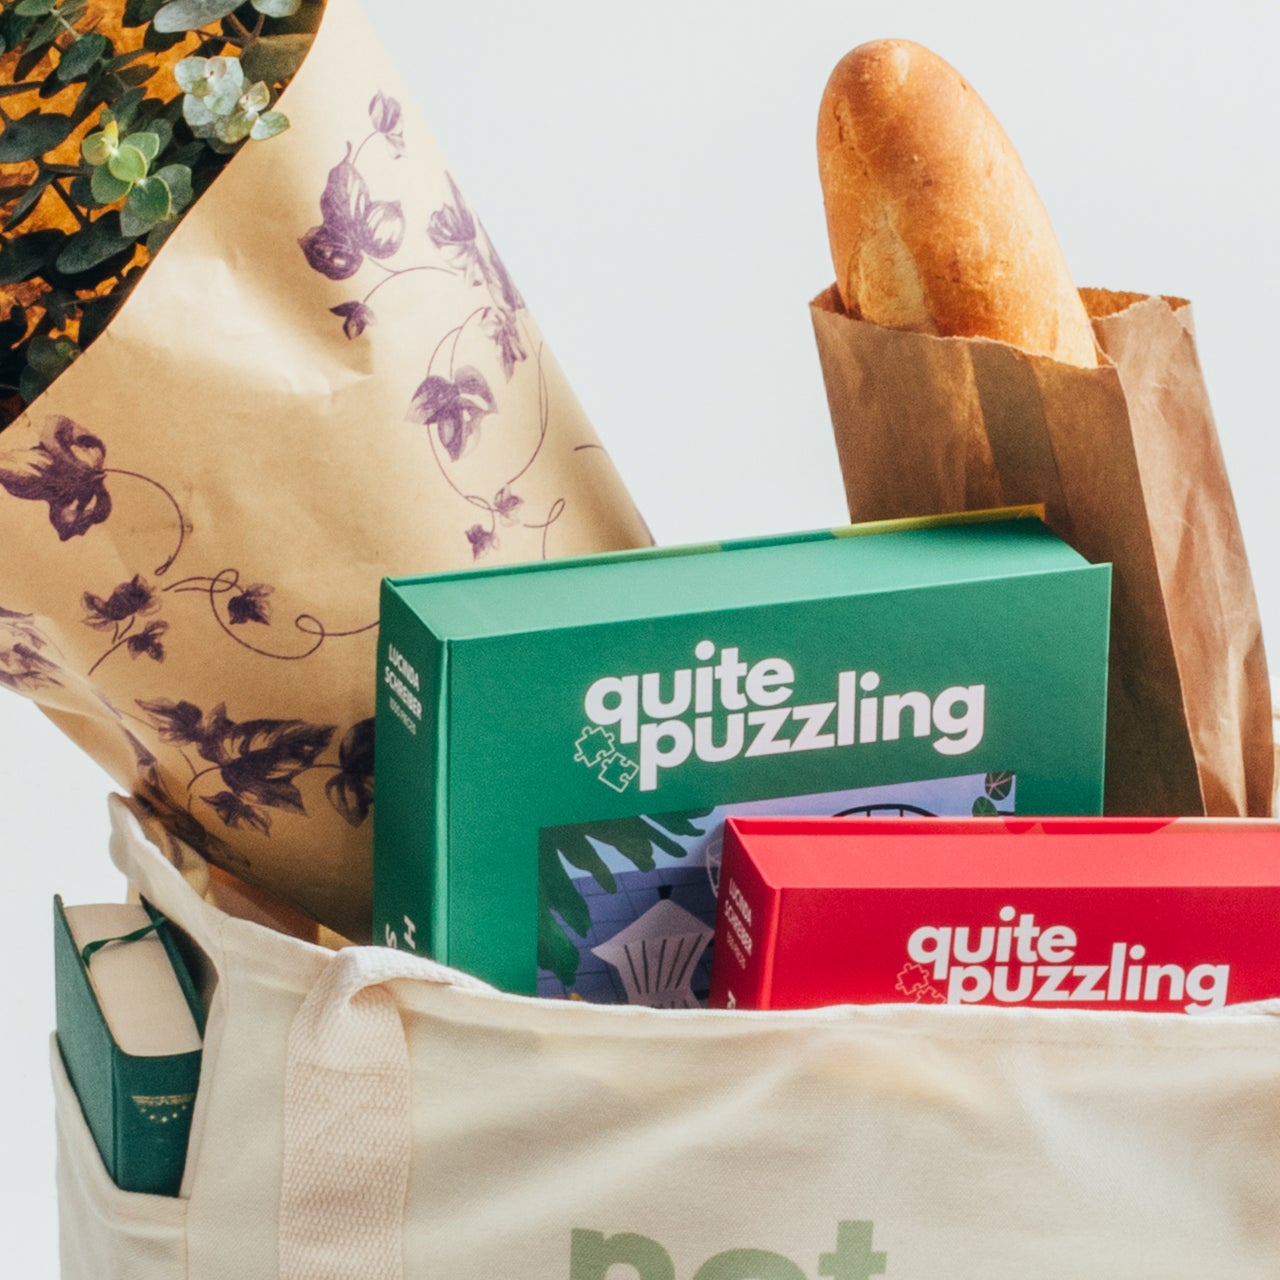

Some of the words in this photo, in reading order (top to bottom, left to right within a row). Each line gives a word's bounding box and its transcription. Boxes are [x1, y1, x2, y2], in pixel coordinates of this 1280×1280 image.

[583, 639, 796, 745] quite
[638, 669, 987, 793] puzzling
[906, 905, 1078, 981] quite
[945, 941, 1231, 1016] puzzling
